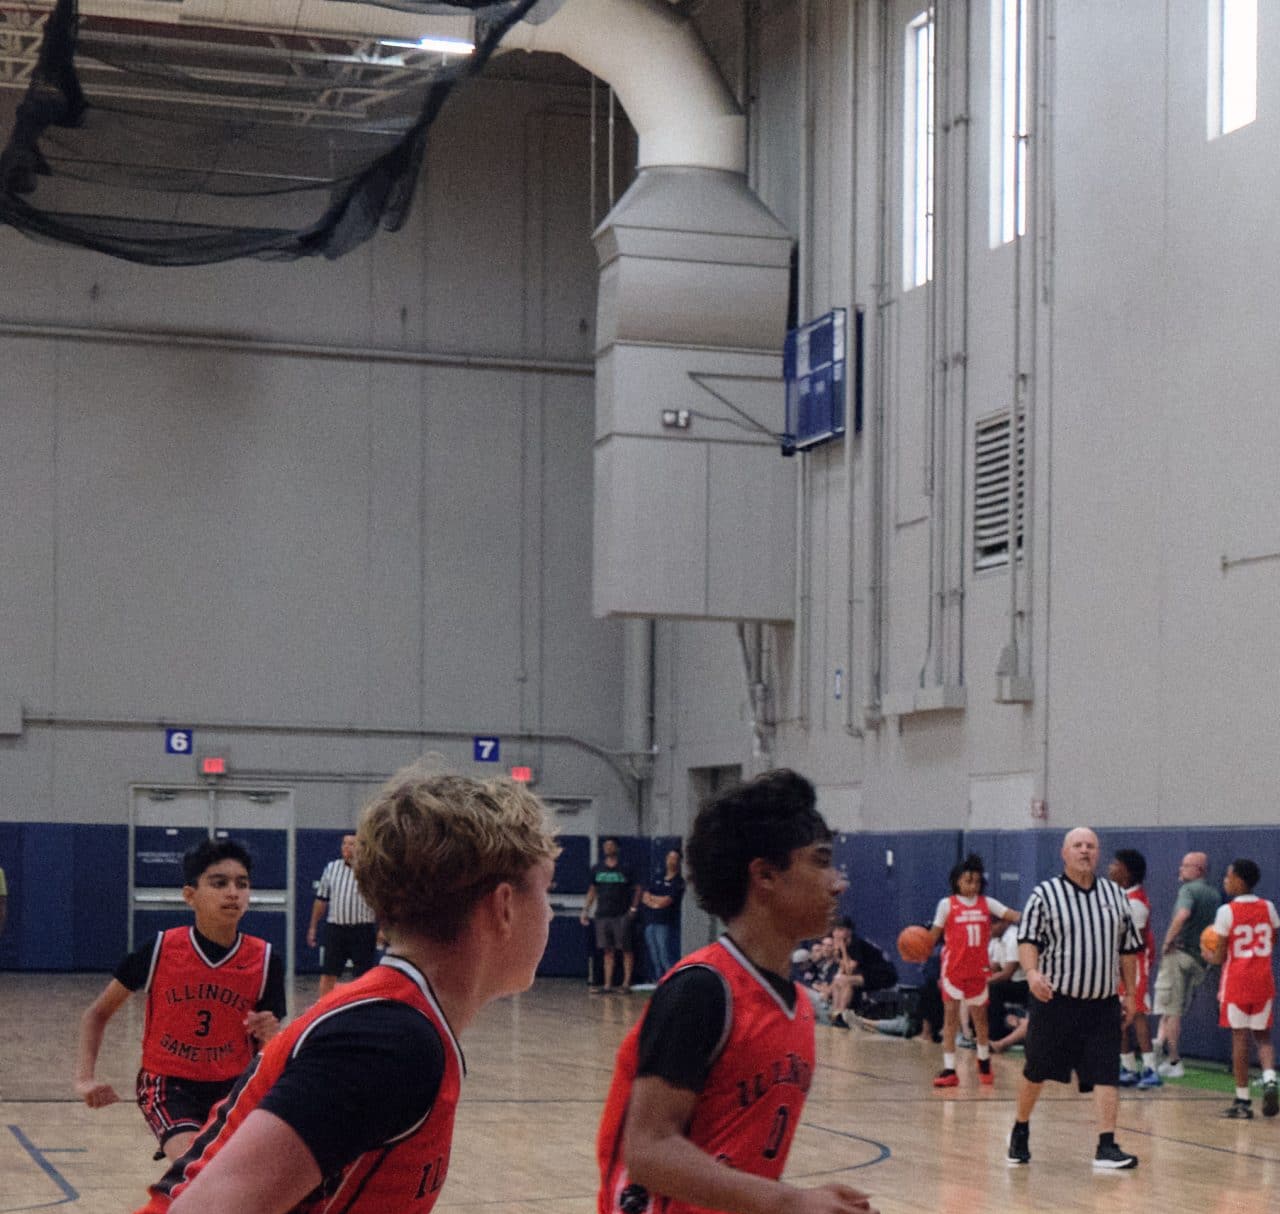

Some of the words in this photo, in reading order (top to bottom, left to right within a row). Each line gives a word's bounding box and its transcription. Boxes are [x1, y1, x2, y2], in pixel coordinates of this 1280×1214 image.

[170, 733, 188, 751] 6
[478, 740, 496, 759] 7
[966, 924, 980, 947] 11
[1233, 923, 1272, 958] 23
[165, 983, 248, 1012] ILLINOIS
[195, 1010, 212, 1037] 3
[161, 1033, 200, 1062] GAME
